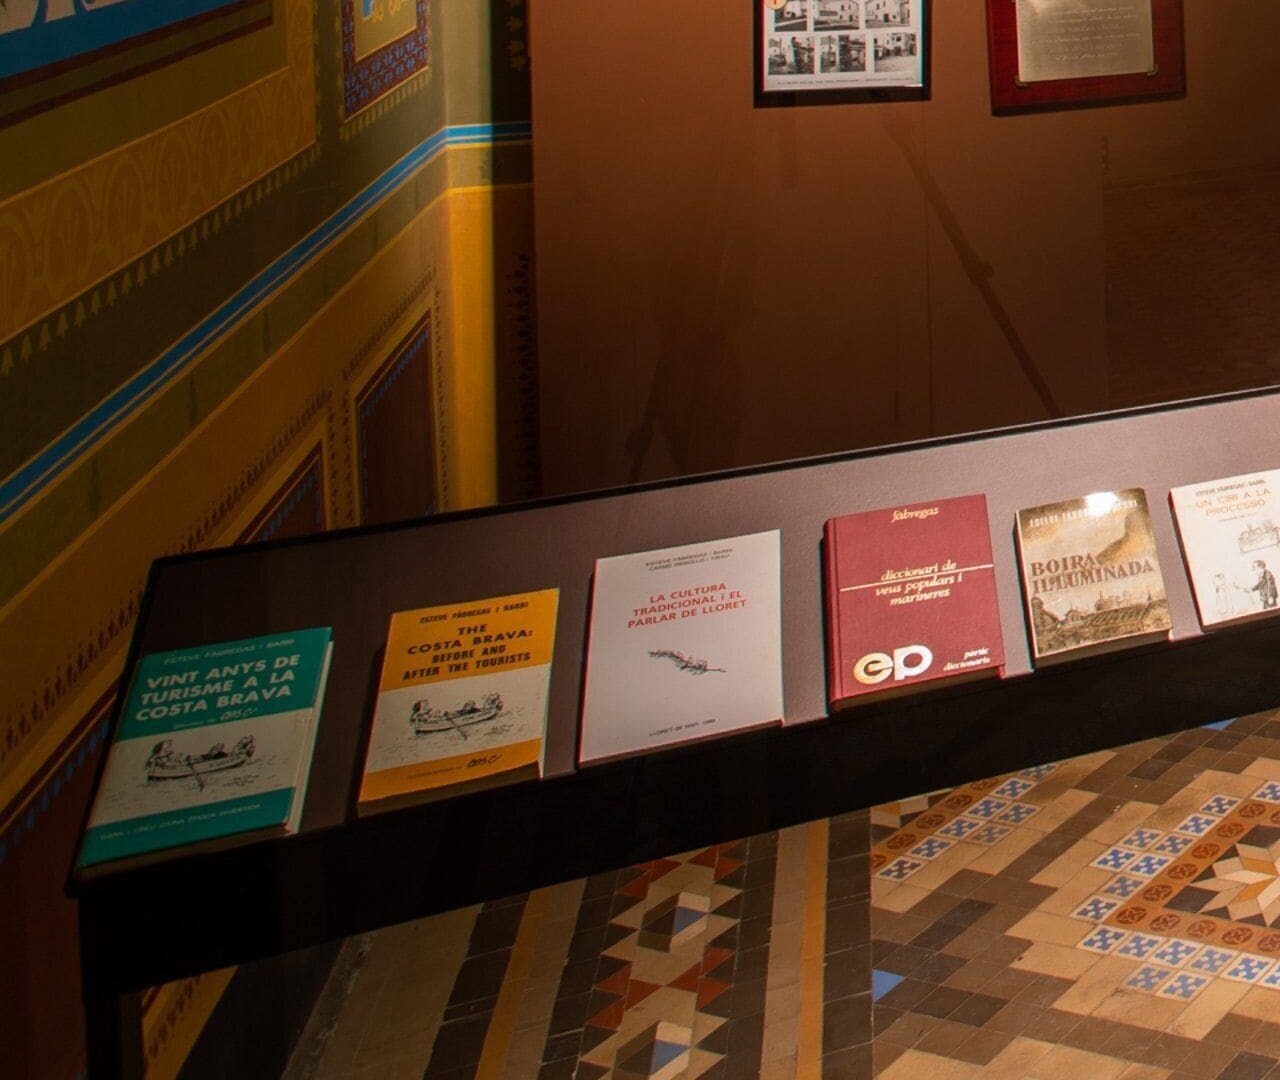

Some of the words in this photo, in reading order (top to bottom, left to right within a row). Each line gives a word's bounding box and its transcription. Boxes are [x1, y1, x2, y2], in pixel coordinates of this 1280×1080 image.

[1195, 498, 1213, 509] UN
[1243, 491, 1252, 499] A
[1256, 487, 1271, 497] LA
[880, 562, 938, 582] diccionari
[942, 560, 957, 571] de
[1030, 552, 1097, 577] BOIRA
[650, 593, 666, 604] LA
[670, 583, 727, 600] CULTURA
[875, 583, 902, 596] veus
[905, 574, 955, 595] populars
[889, 588, 950, 606] marineres
[627, 612, 677, 629] PARLAR
[681, 608, 698, 619] DE
[702, 599, 748, 615] LLORET
[632, 595, 716, 617] TRADICIONAL
[729, 591, 743, 600] EL
[408, 640, 461, 655] COSTA
[472, 629, 533, 645] BRAVA:
[457, 624, 488, 636] THE
[403, 666, 440, 681] AFTER
[448, 662, 469, 674] THE
[475, 652, 531, 669] TOURISTS
[432, 649, 475, 664] BEFORE
[481, 645, 506, 656] AND
[147, 671, 200, 689] VINT
[205, 661, 266, 679] ANYS
[273, 654, 301, 668] DE
[140, 679, 233, 706] TURISME
[242, 676, 259, 689] A
[270, 670, 296, 684] LA
[135, 700, 208, 721] COSTA
[216, 685, 292, 708] BRAVA
